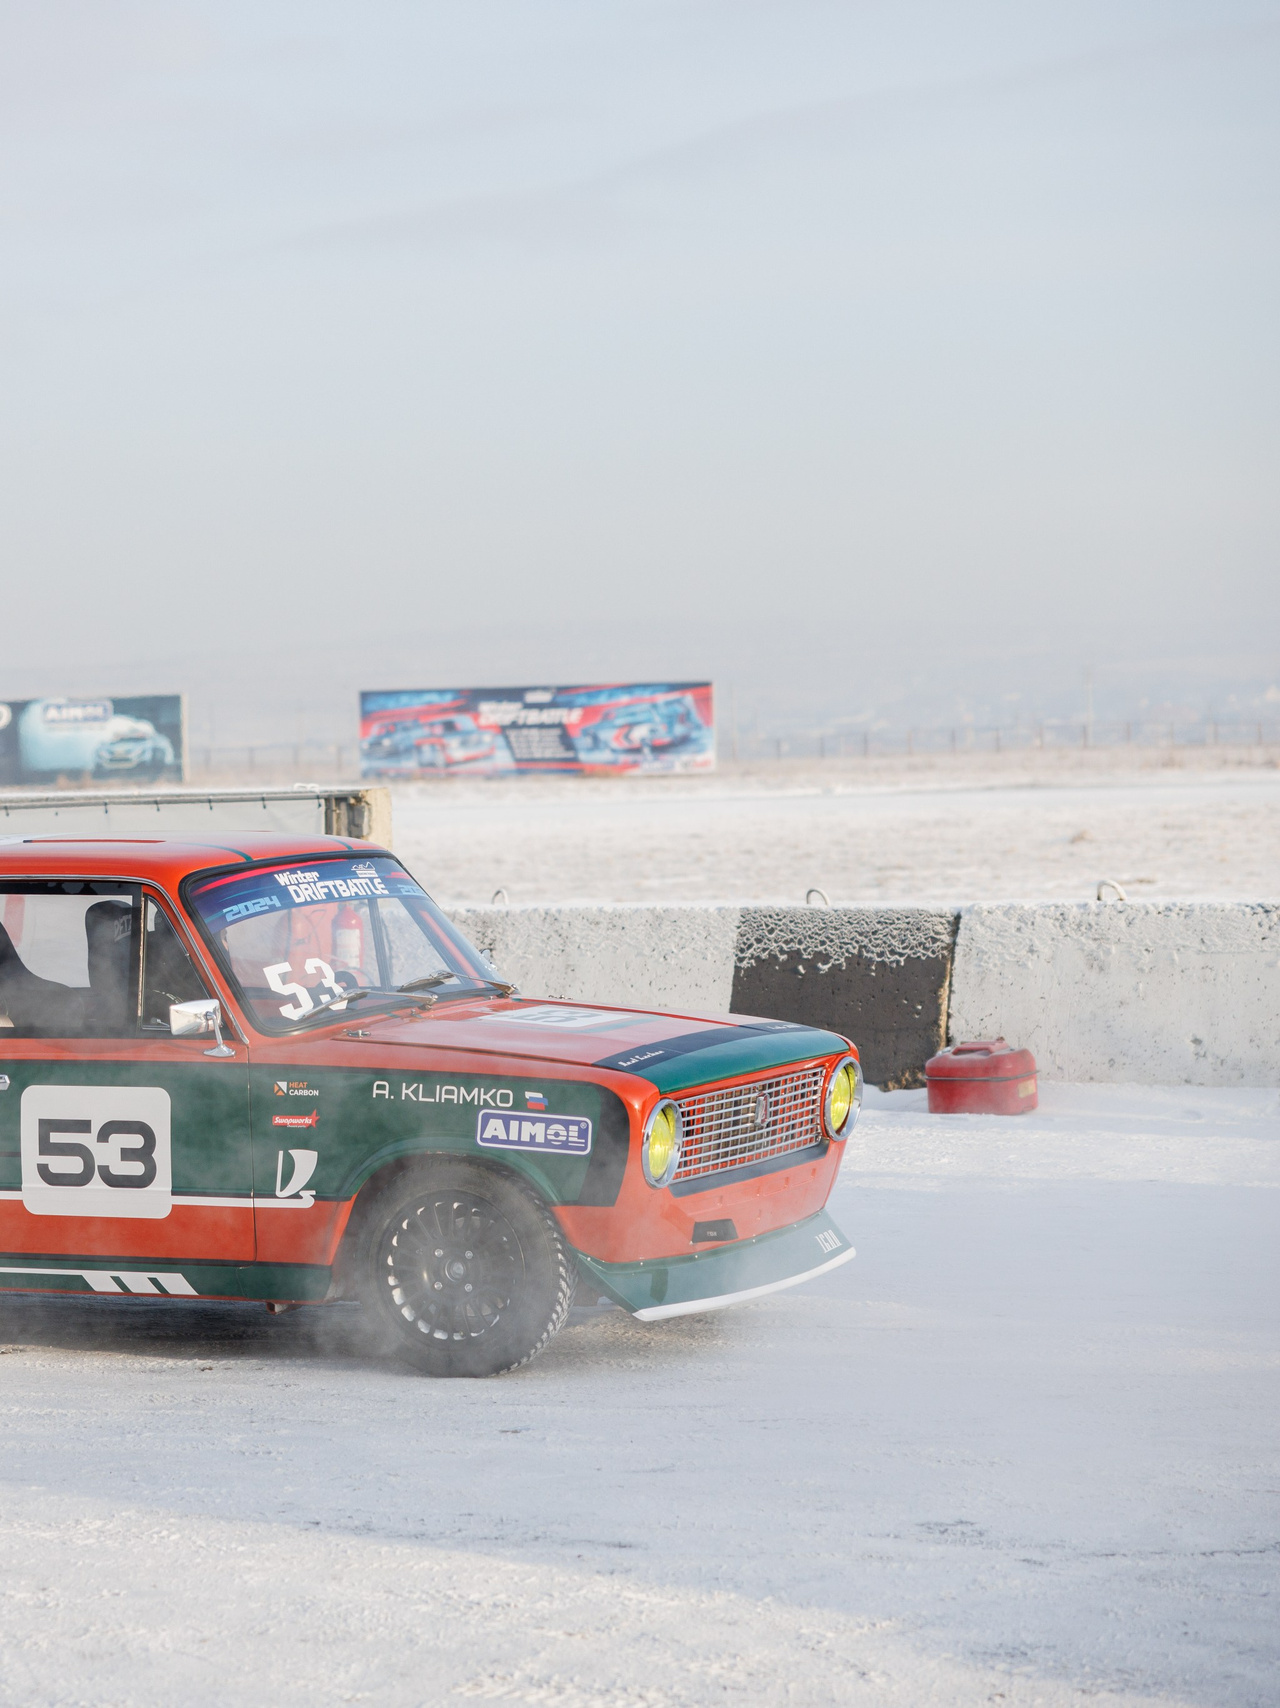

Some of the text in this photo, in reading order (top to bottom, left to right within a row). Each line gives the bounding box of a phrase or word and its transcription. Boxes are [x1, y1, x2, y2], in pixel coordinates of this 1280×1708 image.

[222, 895, 282, 922] 2024
[287, 878, 390, 903] DRIFTBATTLE
[274, 870, 320, 887] Winter
[263, 958, 348, 1020] 53
[372, 1081, 514, 1107] A. KLIAMKO
[36, 1118, 157, 1189] 53
